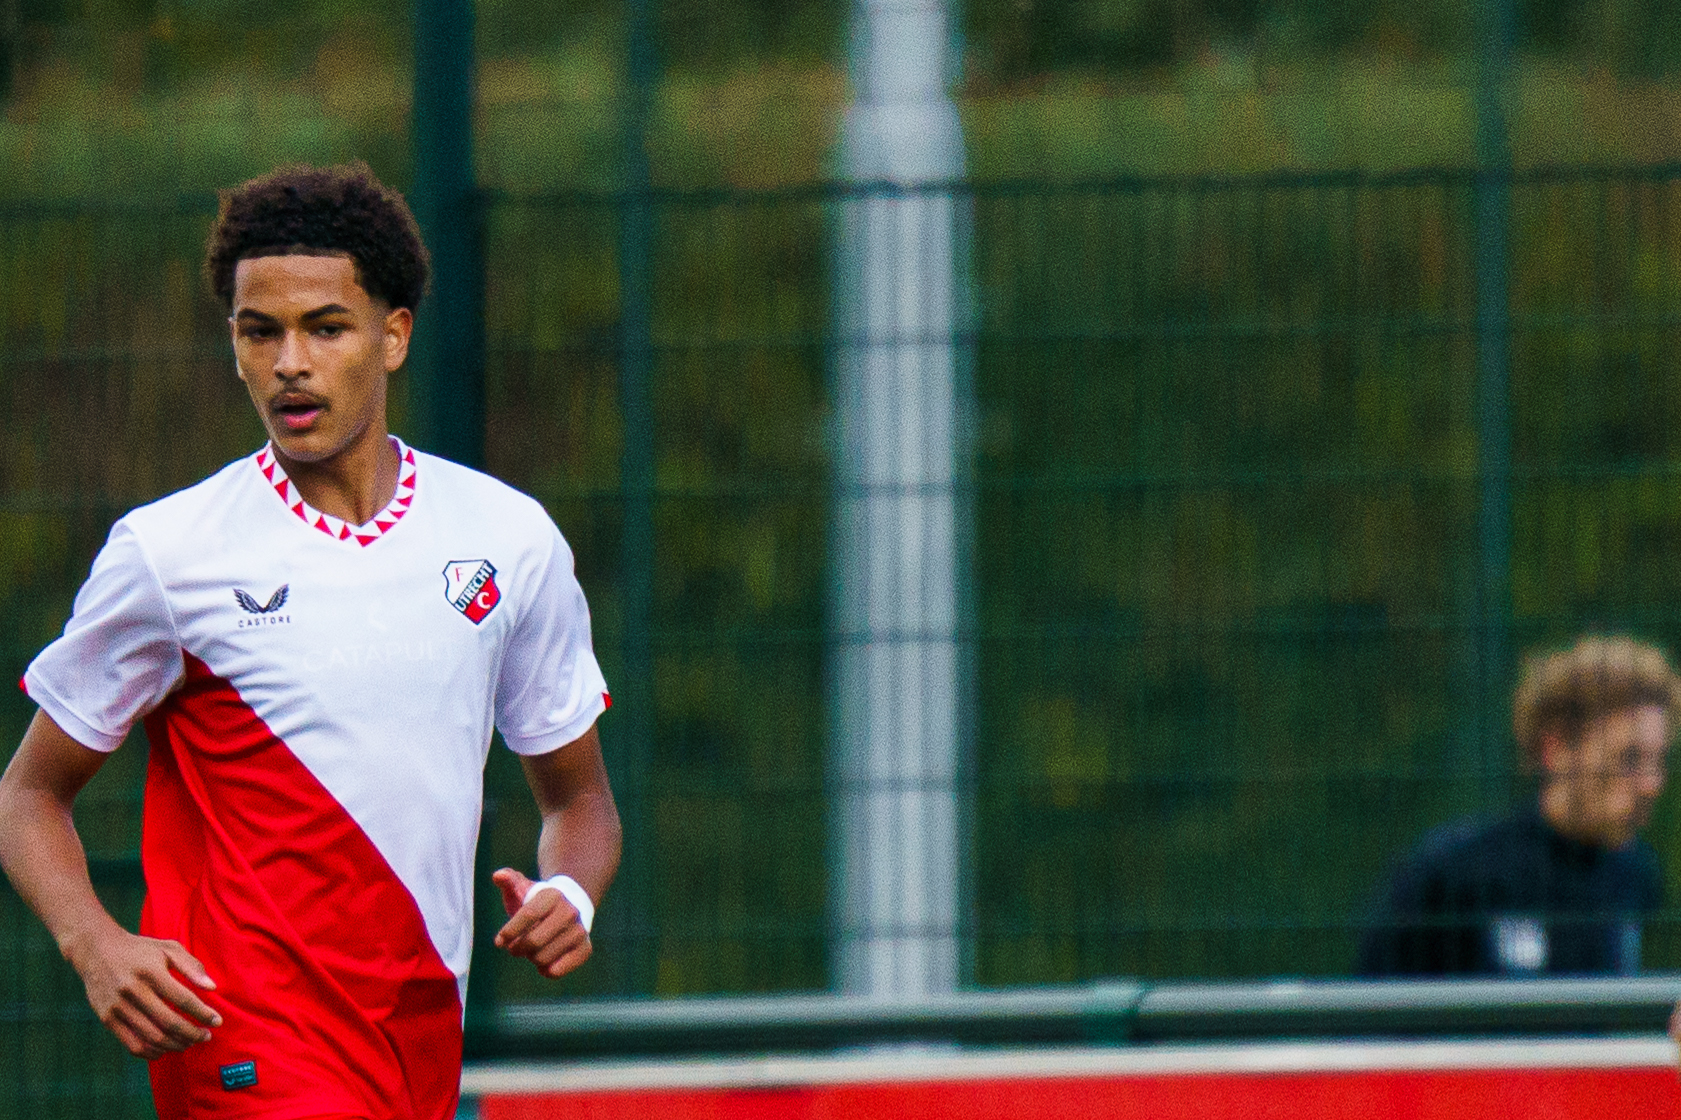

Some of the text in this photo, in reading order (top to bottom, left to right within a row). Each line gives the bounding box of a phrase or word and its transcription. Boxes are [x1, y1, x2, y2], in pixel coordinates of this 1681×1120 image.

[455, 567, 463, 582] F
[454, 563, 493, 612] UTRECHT
[477, 591, 491, 610] C
[238, 615, 291, 628] CASTORE
